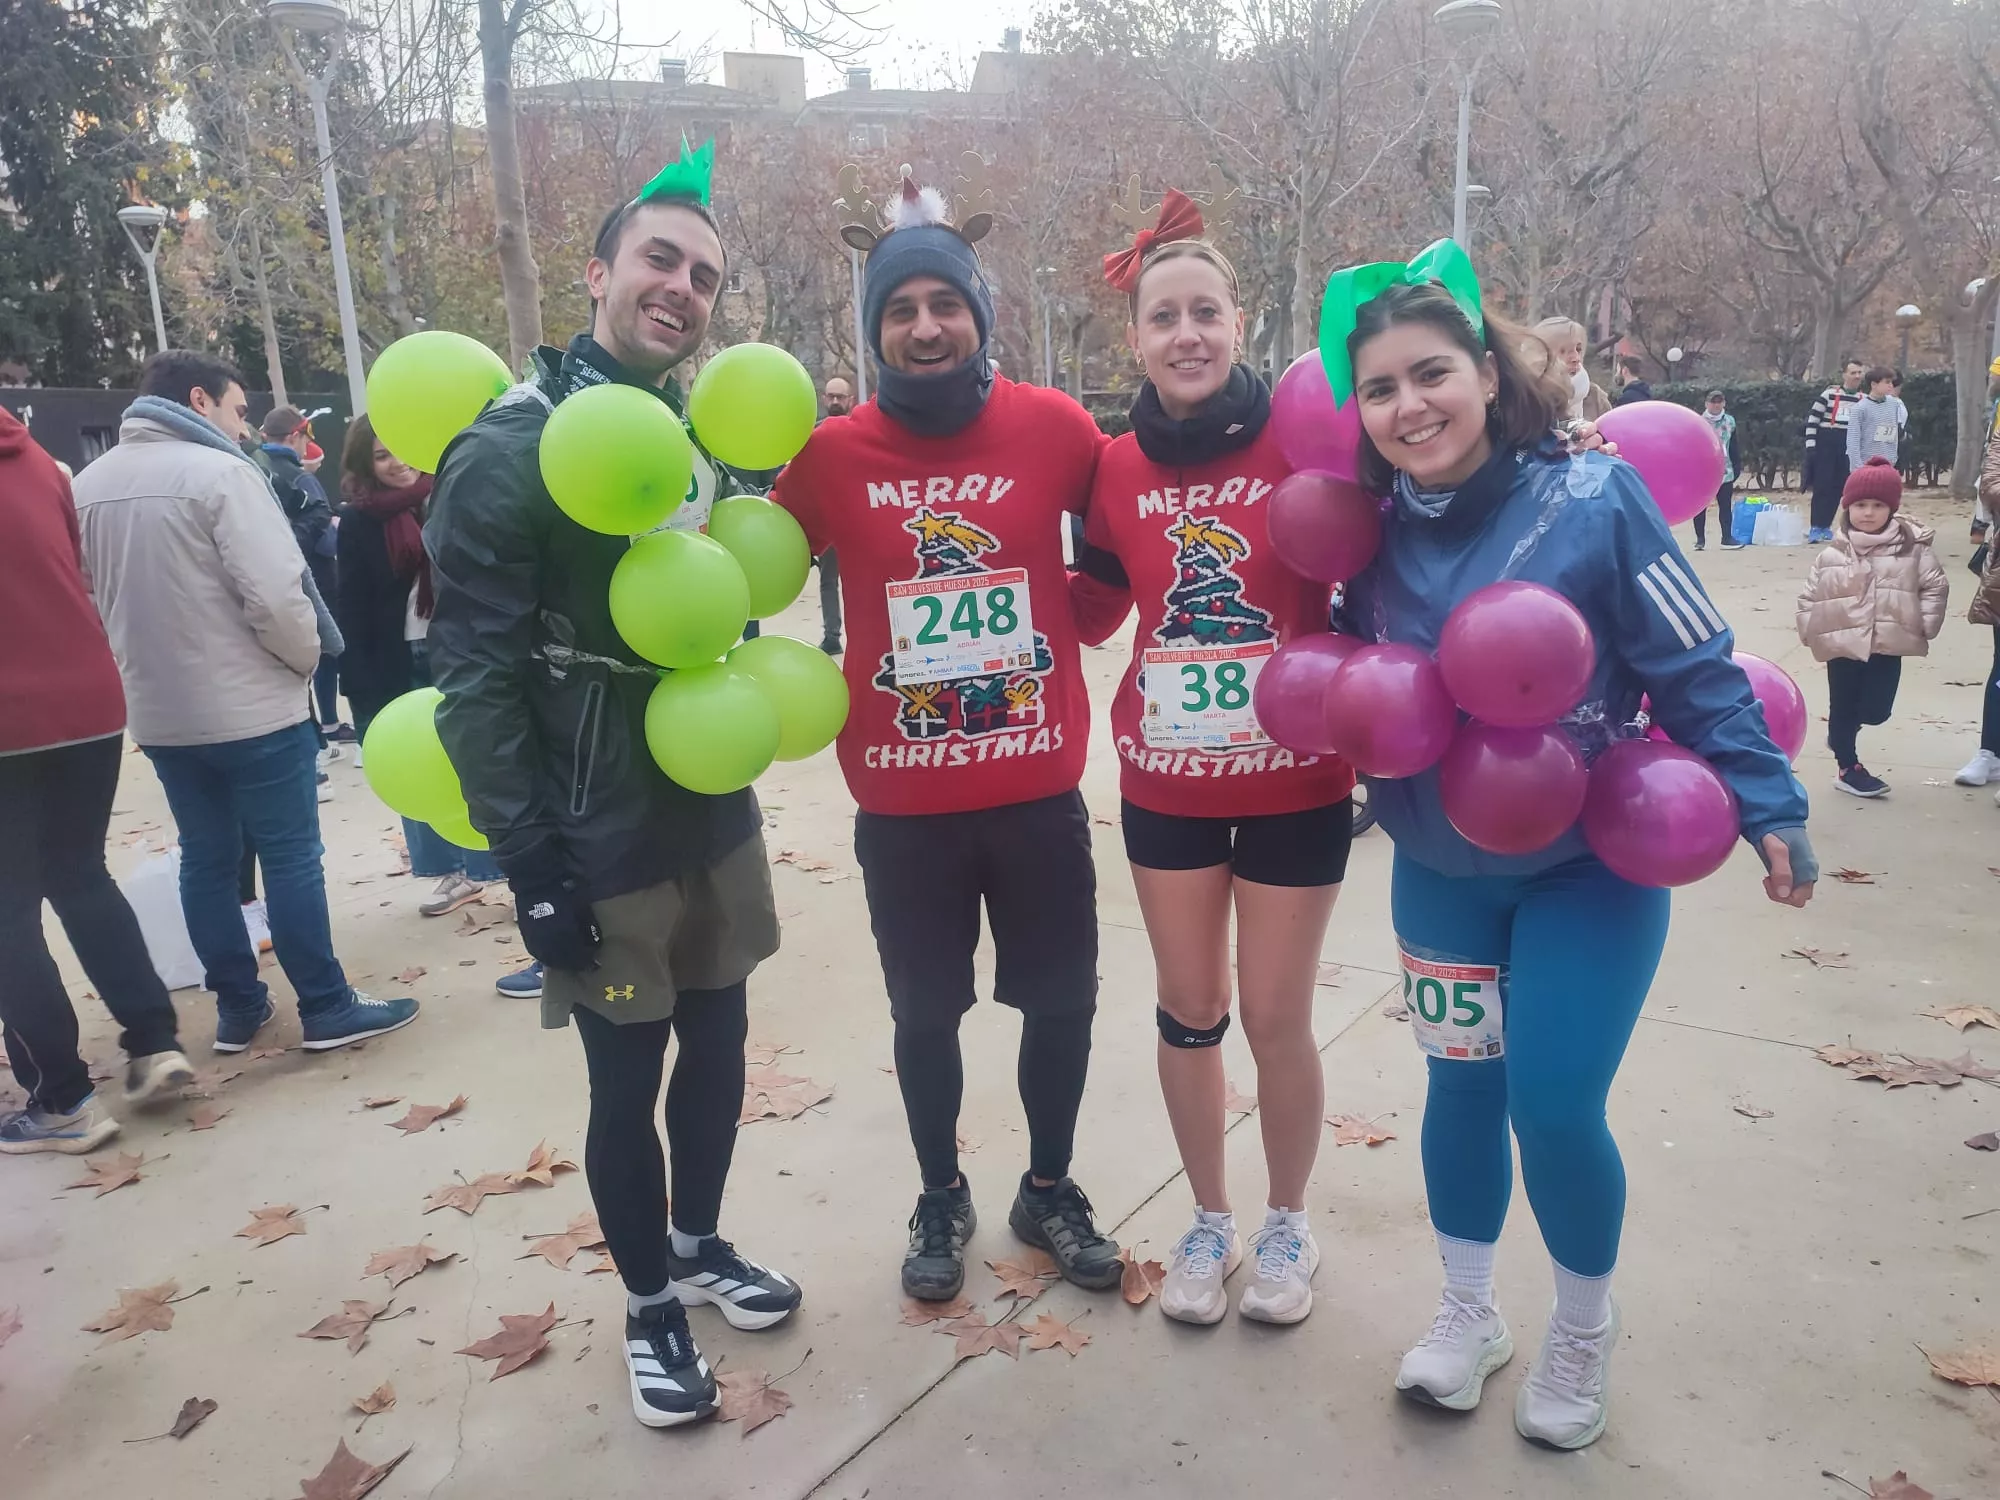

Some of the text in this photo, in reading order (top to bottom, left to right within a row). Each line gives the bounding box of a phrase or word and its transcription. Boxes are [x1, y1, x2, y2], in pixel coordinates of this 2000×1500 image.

[866, 473, 1015, 509] MERRY
[1137, 476, 1274, 520] MERRY
[893, 586, 908, 597] SAN
[908, 582, 943, 595] SILVESTRE
[944, 579, 971, 592] HUESCA
[972, 576, 990, 588] 2025
[912, 586, 1019, 645] 248
[1149, 652, 1161, 662] SAN
[1162, 651, 1191, 661] SILVESTRE
[1193, 650, 1218, 661] HUESCA
[1219, 648, 1237, 659] 2025
[1180, 662, 1250, 712] 38
[865, 723, 1063, 768] CHRISTMAS
[1438, 966, 1457, 978] 2025
